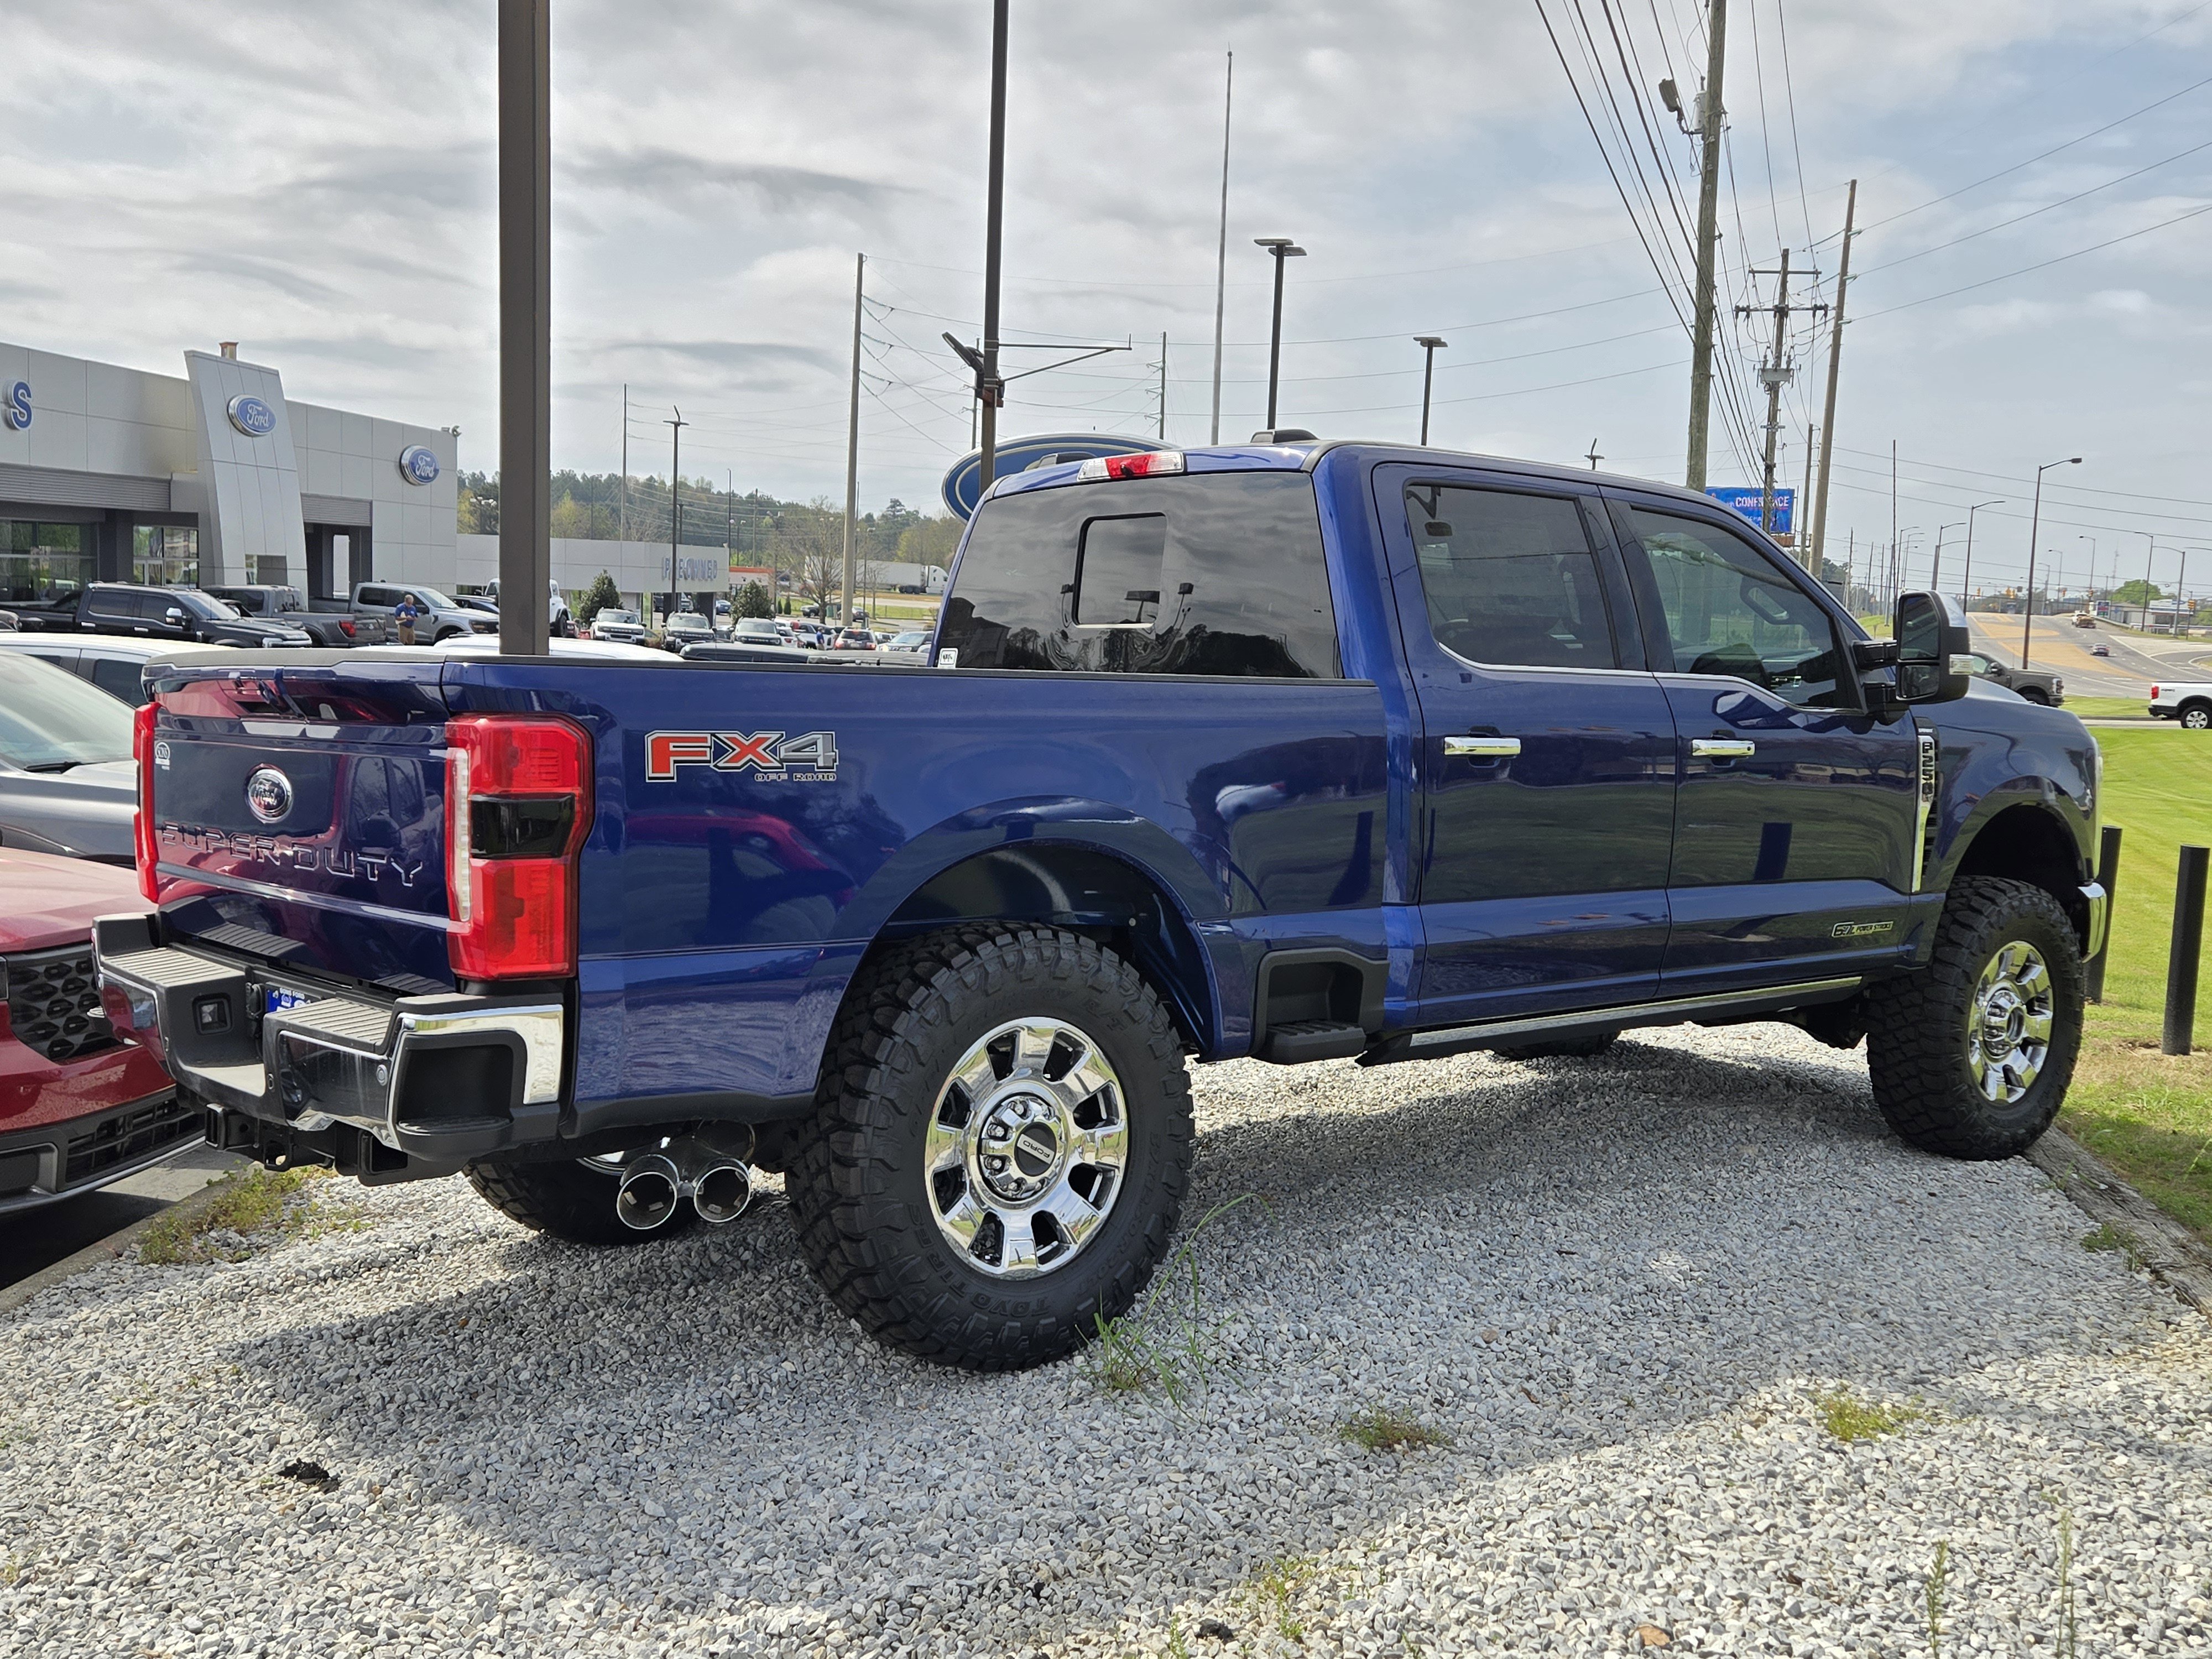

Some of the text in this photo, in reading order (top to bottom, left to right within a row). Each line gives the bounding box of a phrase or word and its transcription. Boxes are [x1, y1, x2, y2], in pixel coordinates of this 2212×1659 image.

[11, 380, 33, 430] S
[246, 403, 270, 427] Ford
[415, 455, 435, 478] Ford
[1735, 495, 1790, 507] CONFINCE
[663, 556, 718, 580] PE-OWNED
[645, 730, 838, 782] FX4
[754, 773, 837, 782] OFF ROAD
[162, 821, 424, 886] SUPER DUTY
[1023, 1140, 1050, 1158] FORD
[907, 1203, 1050, 1317] TOYO TIRES
